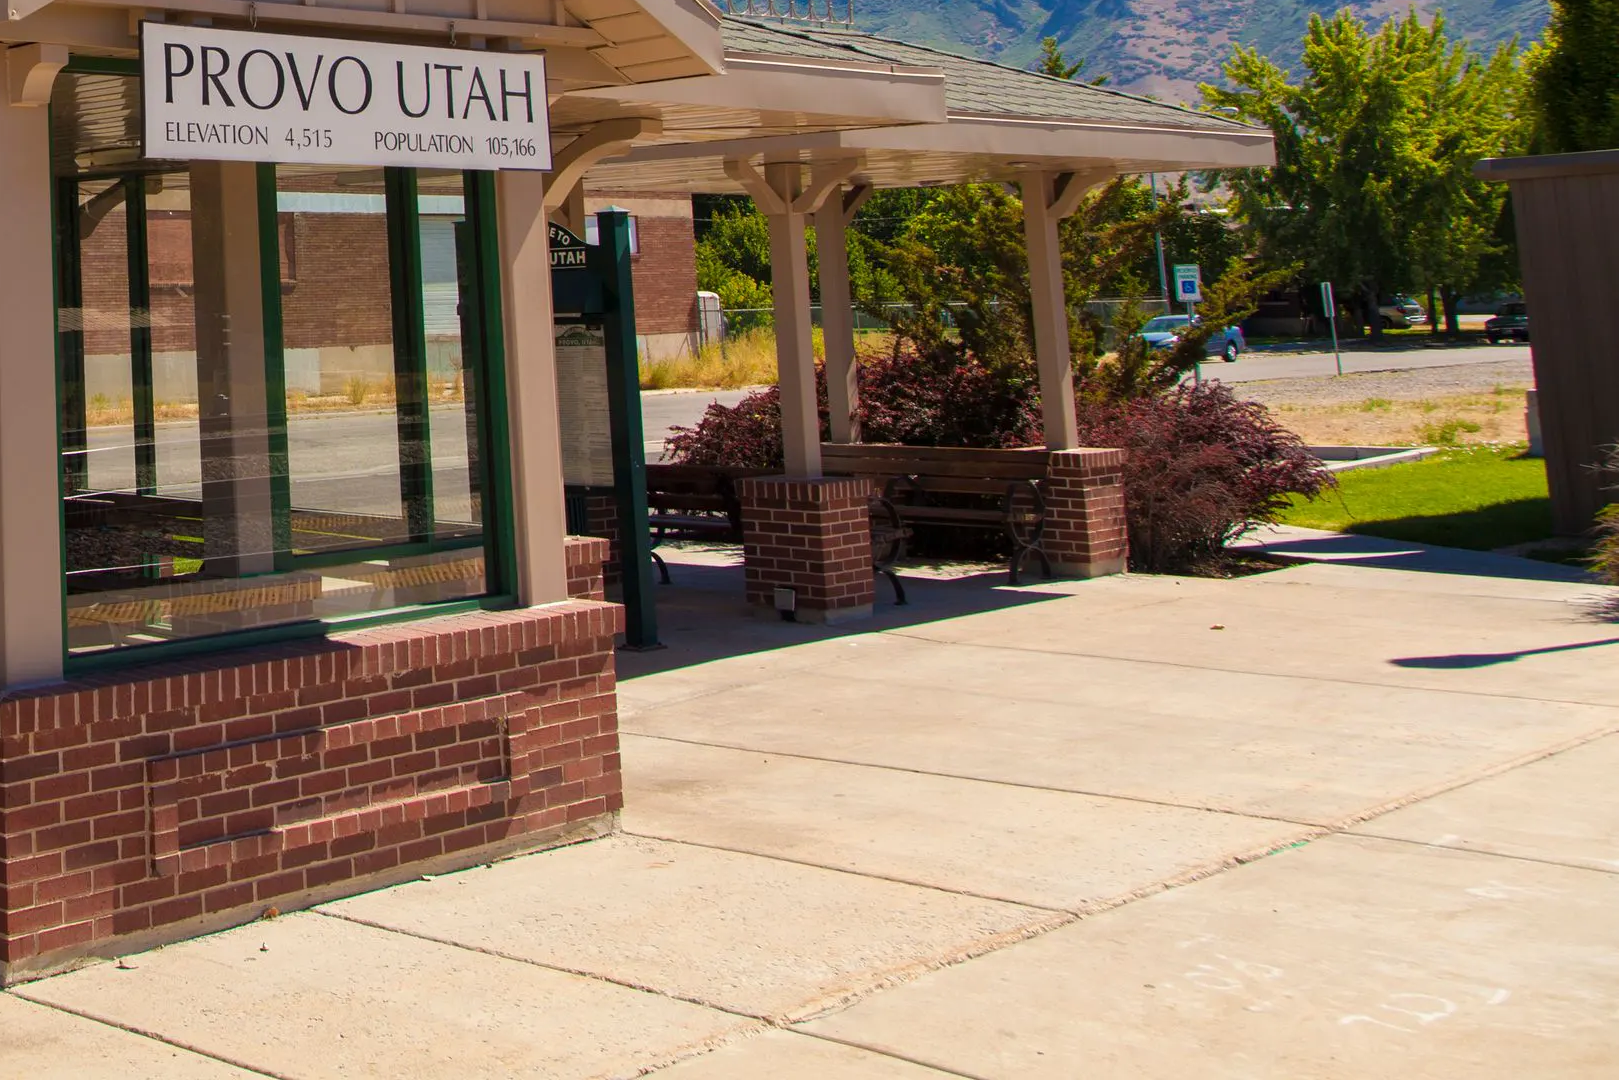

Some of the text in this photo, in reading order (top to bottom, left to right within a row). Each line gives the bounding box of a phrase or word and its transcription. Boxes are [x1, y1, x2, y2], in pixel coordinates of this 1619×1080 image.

[164, 42, 534, 123] PROVO UTAH
[165, 121, 333, 151] ELEVATION 4,515
[374, 131, 537, 159] POPULATION 105,166
[557, 230, 571, 245] TO
[550, 251, 586, 265] UTAH
